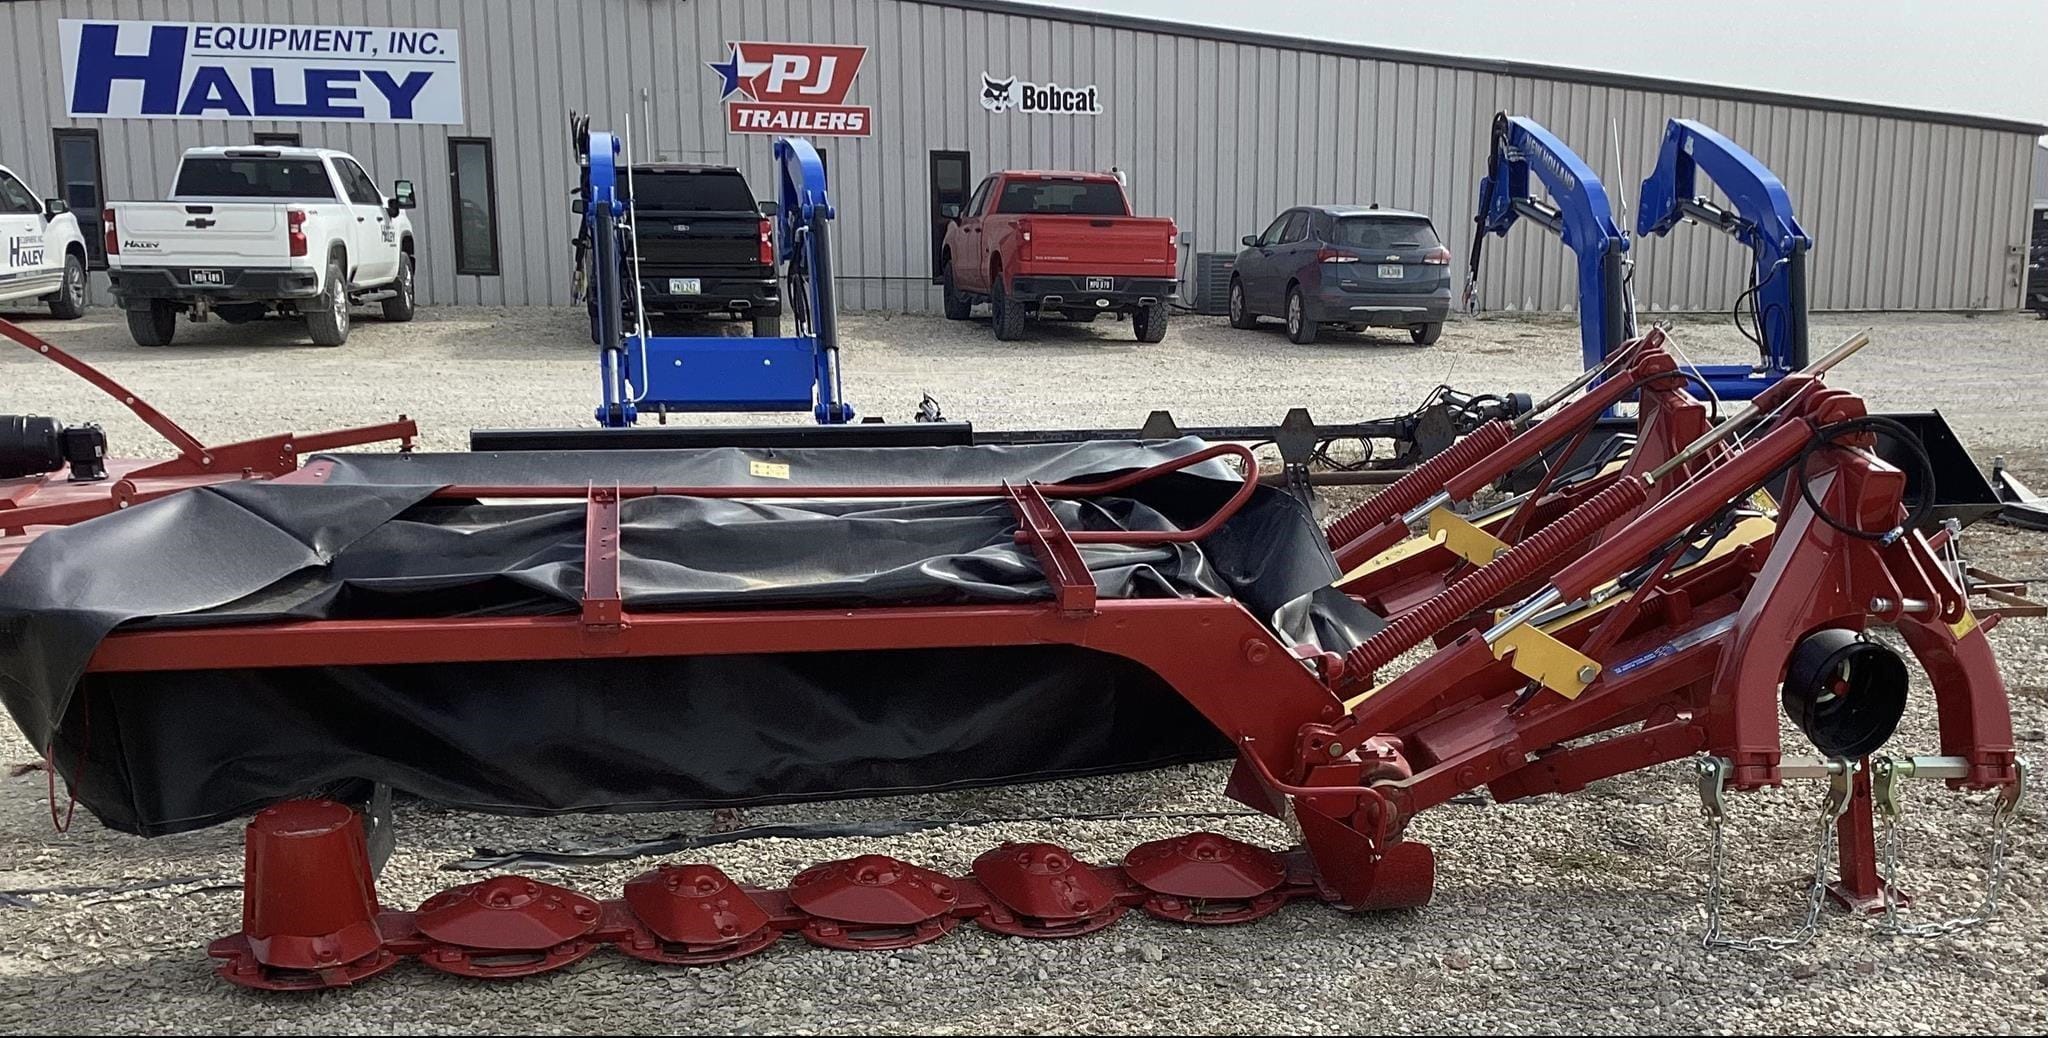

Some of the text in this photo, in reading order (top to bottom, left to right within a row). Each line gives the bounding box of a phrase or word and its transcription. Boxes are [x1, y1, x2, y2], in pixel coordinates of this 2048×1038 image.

[194, 26, 445, 57] EQUIPMENT, INC.
[71, 23, 434, 120] HALEY
[765, 54, 838, 94] PJ
[1022, 85, 1096, 111] Bobcat
[737, 109, 864, 131] TRAILERS
[10, 236, 44, 267] HALEY
[124, 240, 159, 248] HALEY
